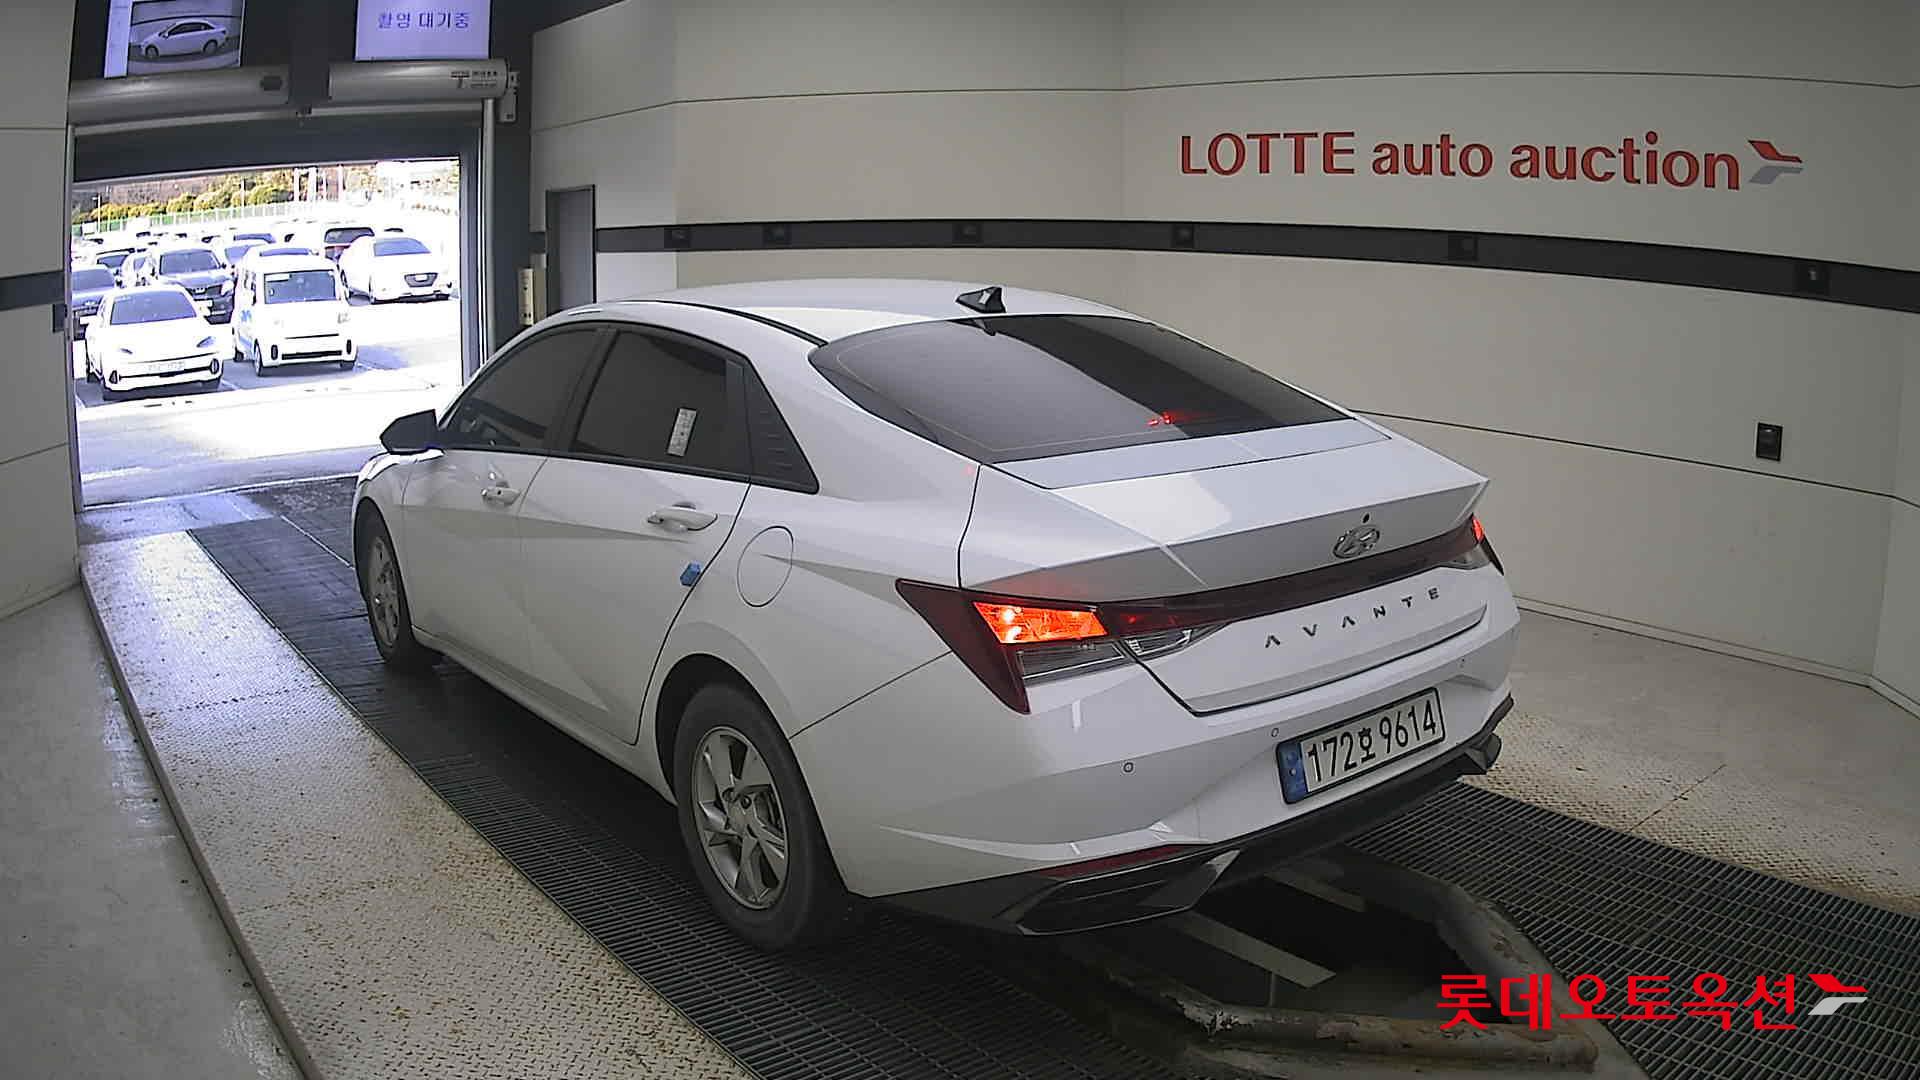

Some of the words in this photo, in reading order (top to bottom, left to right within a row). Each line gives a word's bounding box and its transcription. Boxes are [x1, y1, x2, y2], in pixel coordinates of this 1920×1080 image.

[419, 12, 468, 29] 대기중
[1181, 131, 1355, 175] LOTTE
[1372, 133, 1494, 177] auto
[1509, 131, 1740, 190] auction
[1265, 587, 1440, 648] AVANTE
[1307, 727, 1376, 783] 172호
[1379, 699, 1436, 754] 9614
